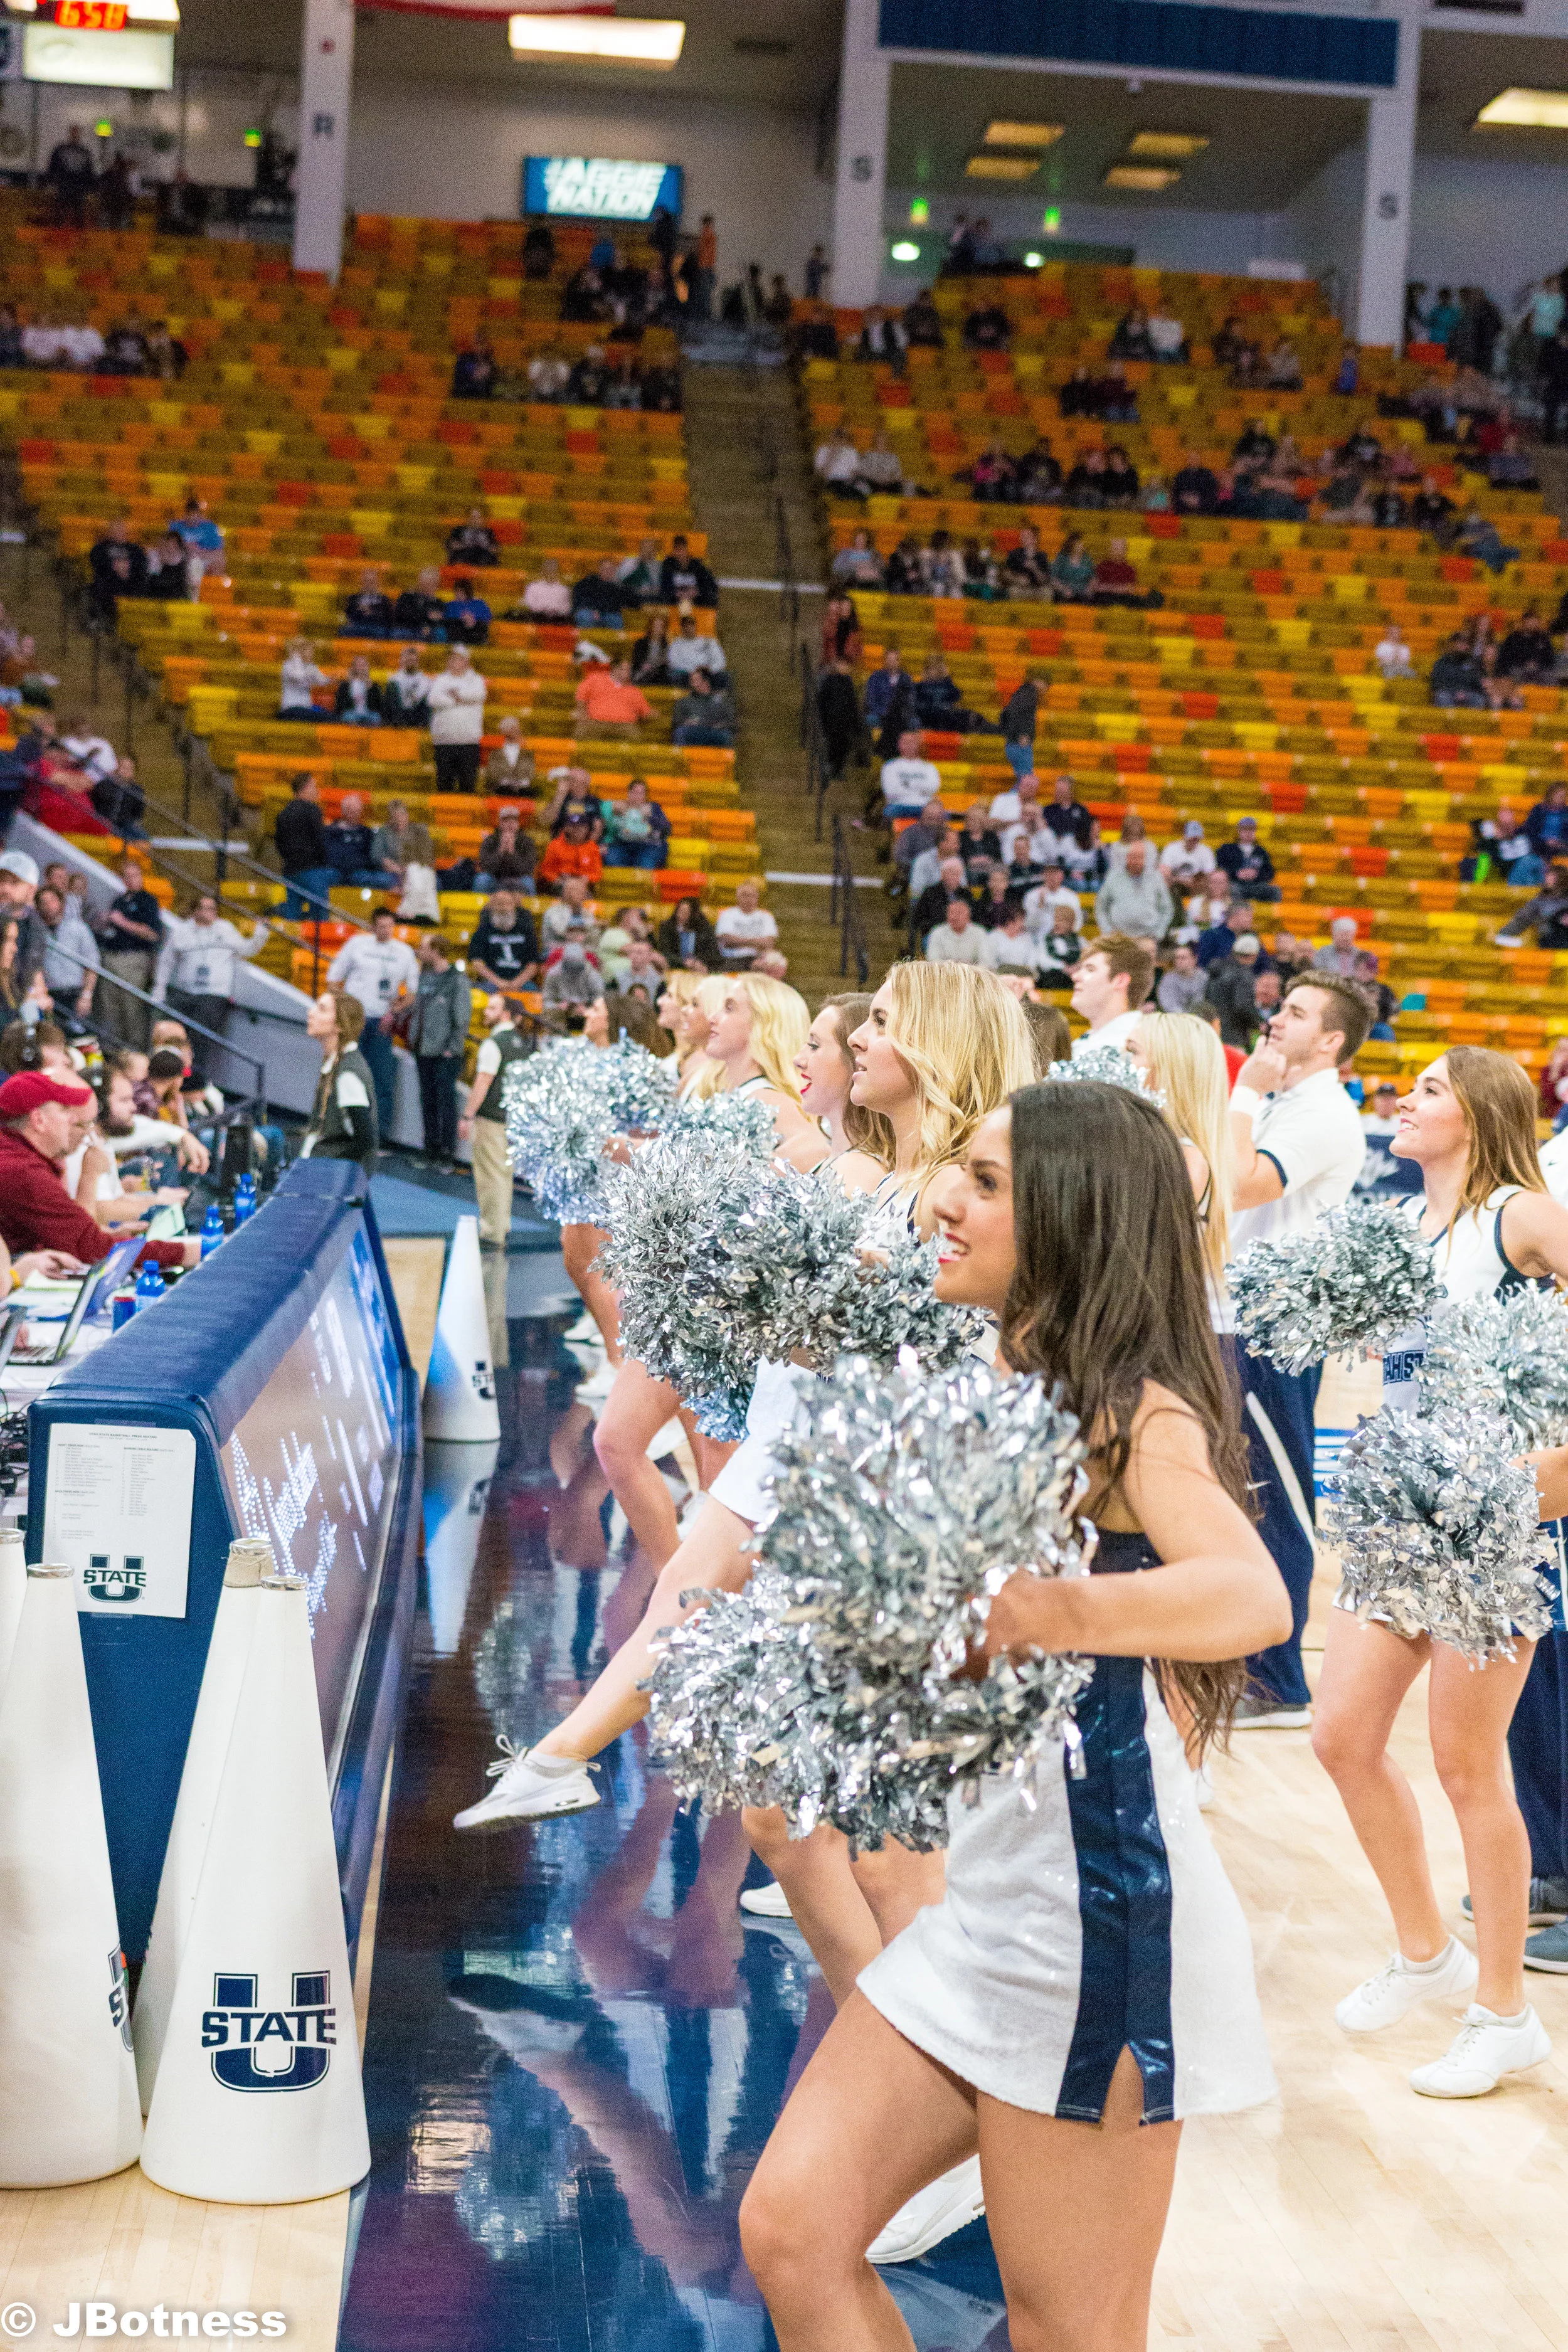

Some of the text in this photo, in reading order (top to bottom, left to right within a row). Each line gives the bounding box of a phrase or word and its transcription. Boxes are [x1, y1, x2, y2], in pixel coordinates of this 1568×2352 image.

[548, 186, 659, 219] NATION
[83, 1569, 147, 1587] STATE
[201, 2008, 337, 2048] STATE
